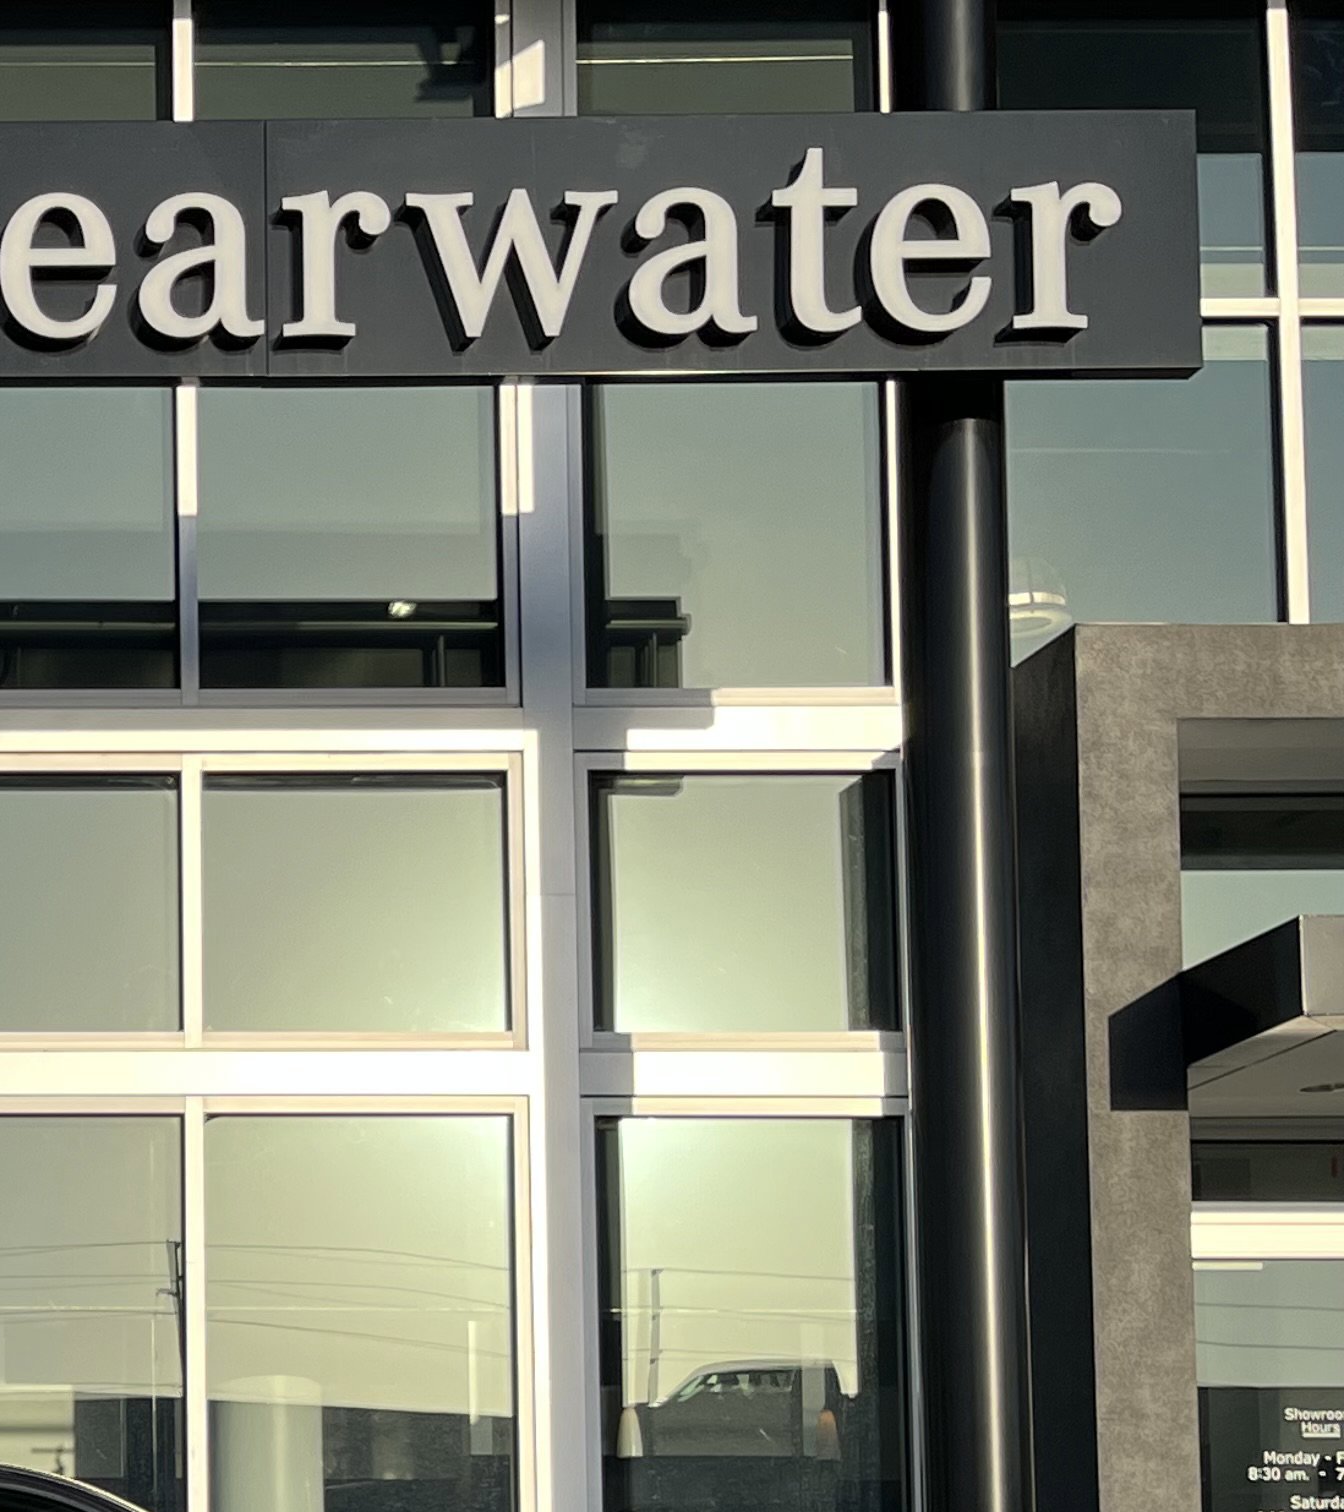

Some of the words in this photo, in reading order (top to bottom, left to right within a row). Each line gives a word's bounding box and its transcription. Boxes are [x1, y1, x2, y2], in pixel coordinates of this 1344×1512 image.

[1284, 1407, 1344, 1421] Showroo
[1301, 1421, 1340, 1435] Hours
[1263, 1450, 1321, 1467] Monday
[1248, 1466, 1281, 1481] 8:30
